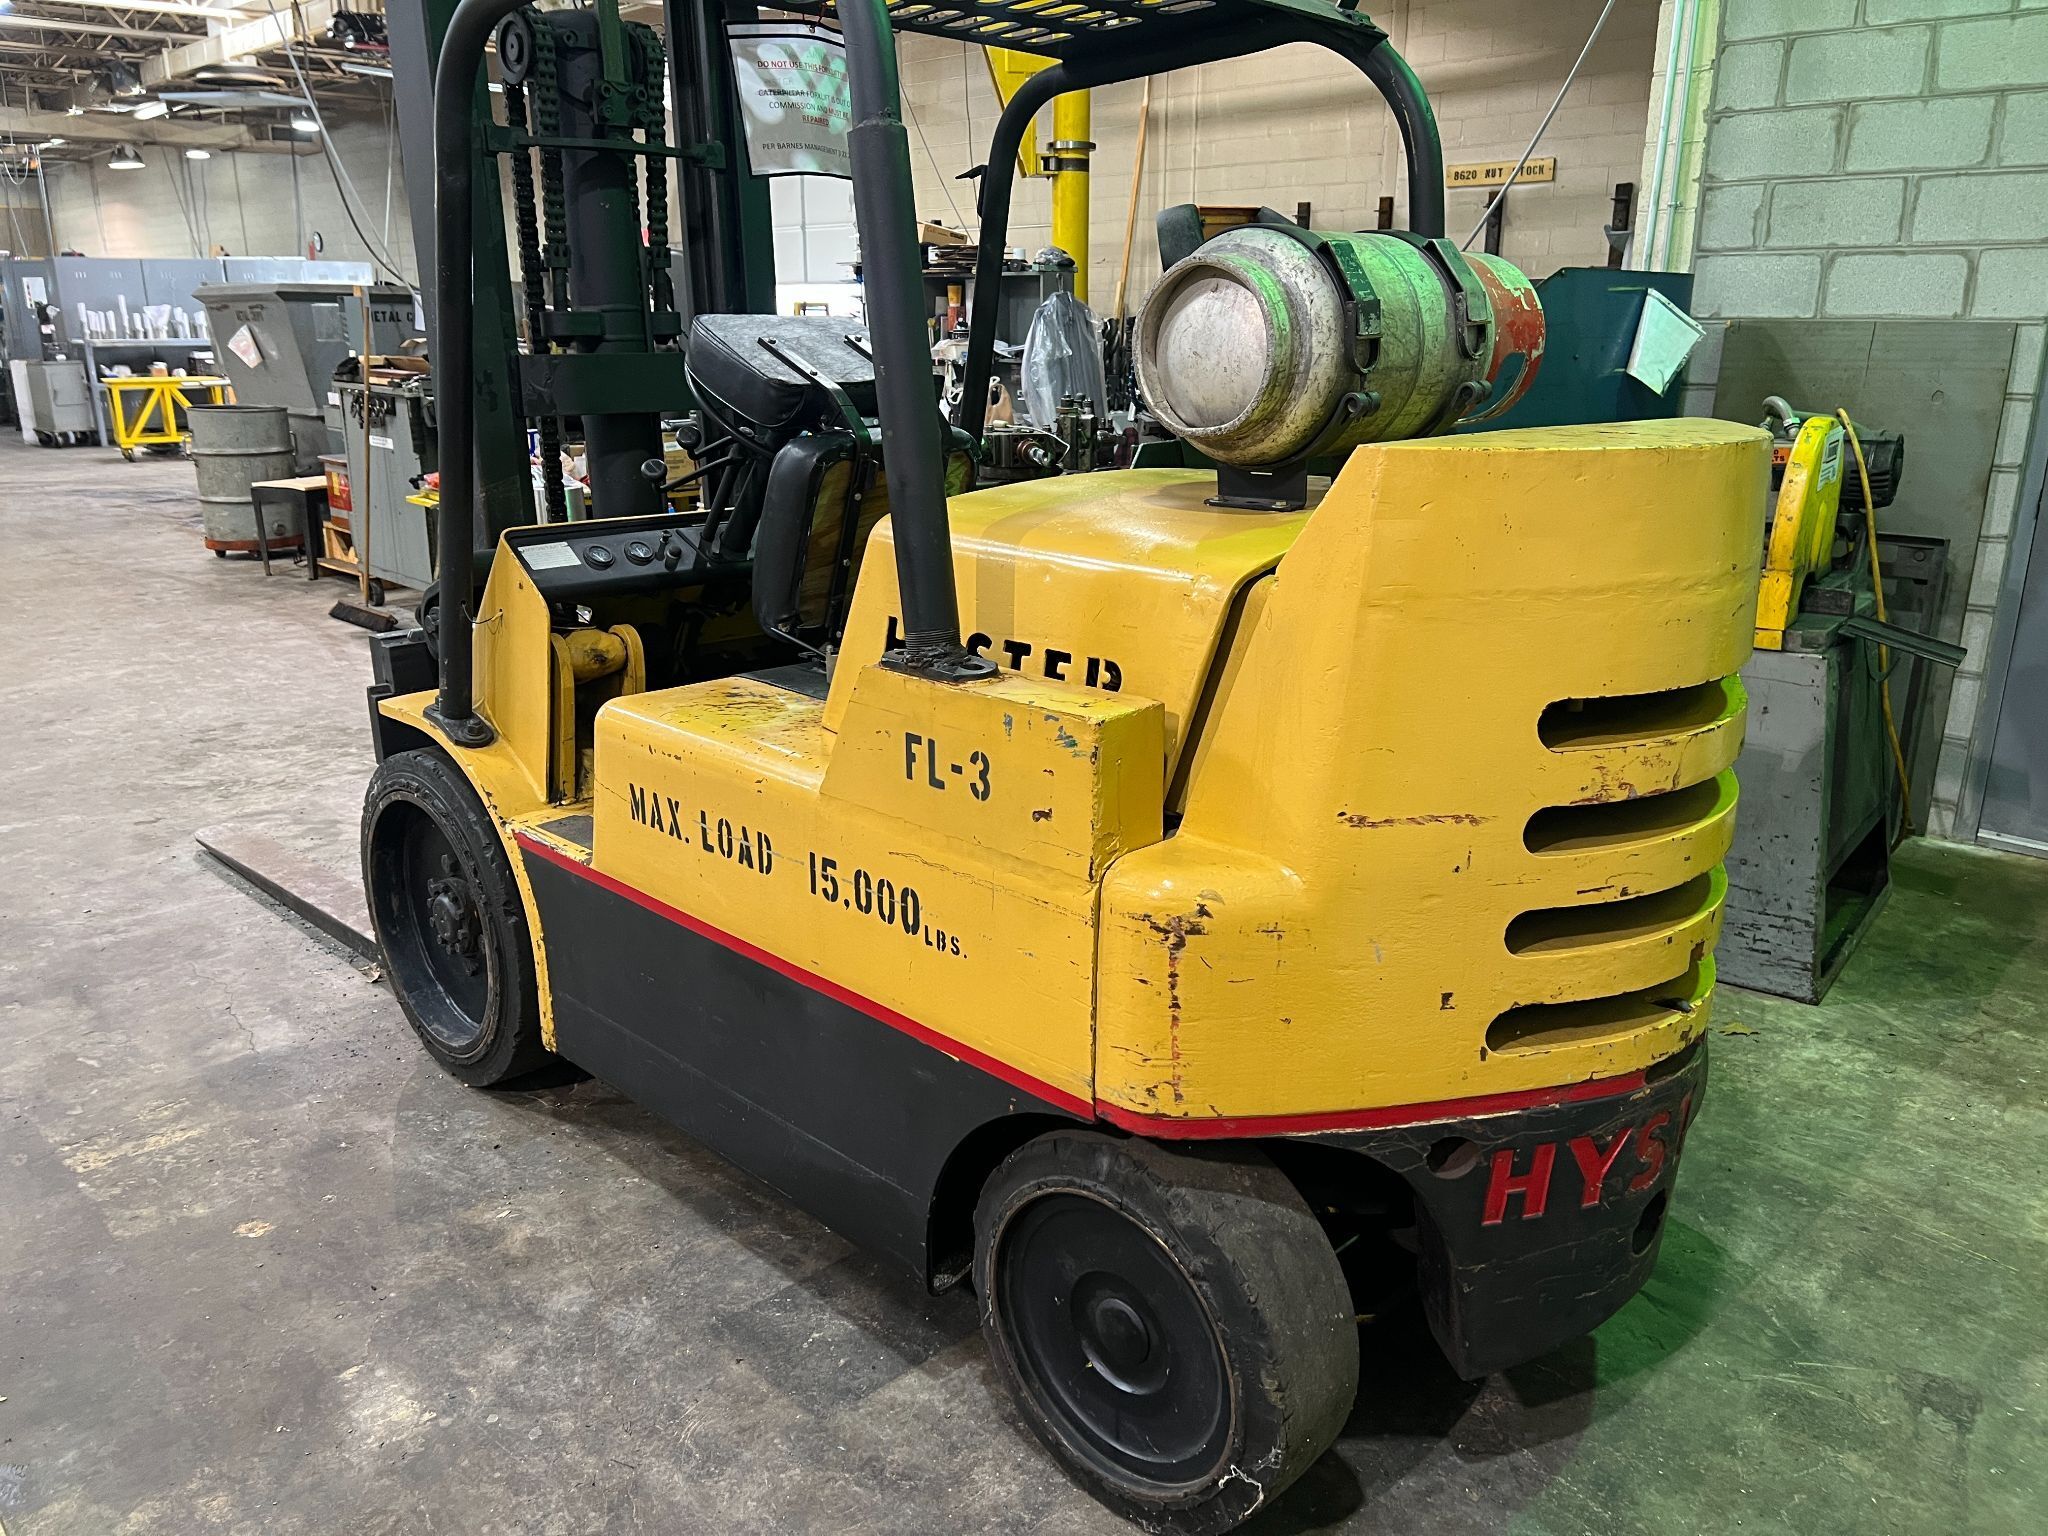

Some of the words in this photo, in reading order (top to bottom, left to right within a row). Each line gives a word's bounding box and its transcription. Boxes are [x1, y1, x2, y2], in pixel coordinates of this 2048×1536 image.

[757, 60, 769, 69] DO
[772, 60, 787, 69] NOT
[789, 60, 803, 70] USE
[804, 61, 817, 71] THIS
[758, 89, 805, 97] CATERPILLAR
[769, 101, 816, 111] COMMISSION
[817, 105, 828, 114] AND
[802, 115, 829, 127] REPAIRED
[762, 142, 776, 150] PER
[776, 142, 804, 151] BARNES
[804, 143, 838, 156] MANAGEMENT
[1453, 170, 1478, 181] 8620
[1484, 167, 1504, 179] NUT
[371, 311, 402, 323] ETAL
[905, 731, 991, 801] FL-3
[629, 782, 690, 844] MAX.
[700, 810, 773, 876] LOAD
[924, 924, 968, 959] LBS.
[1481, 1090, 1692, 1226] HYS
